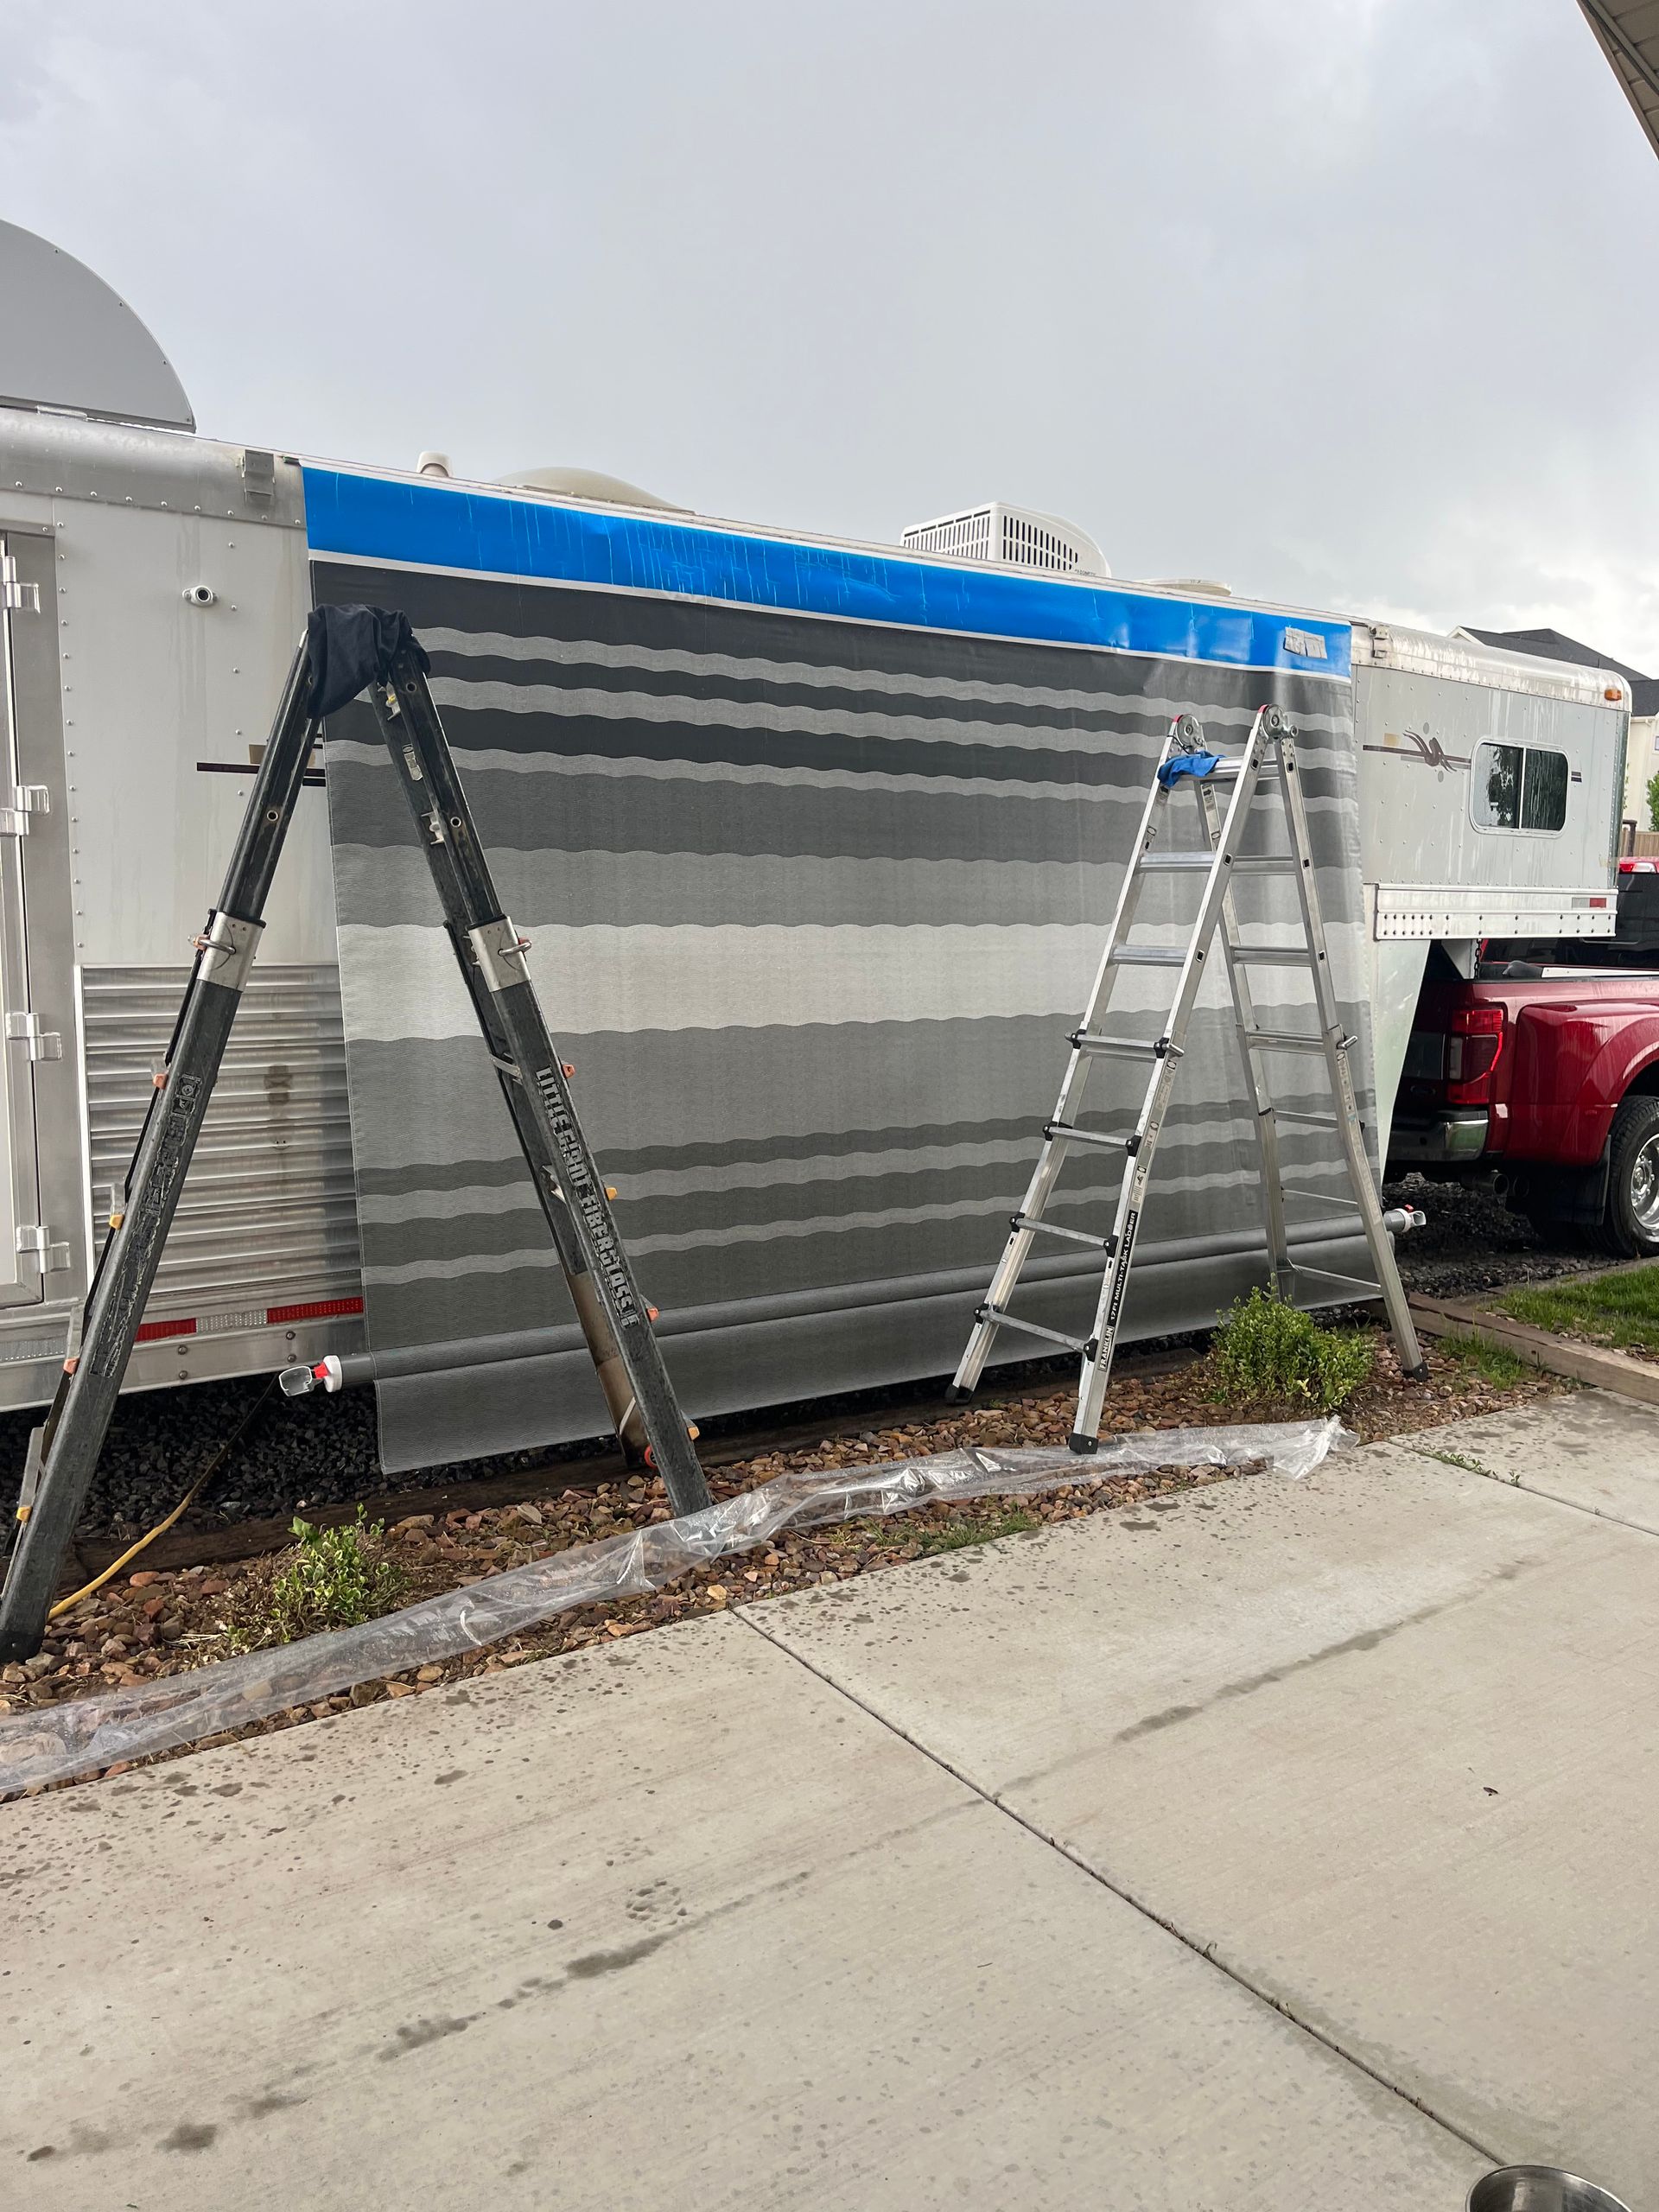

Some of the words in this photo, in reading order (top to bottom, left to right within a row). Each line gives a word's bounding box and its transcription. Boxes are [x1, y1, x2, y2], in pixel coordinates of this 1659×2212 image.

[536, 1065, 570, 1133] LITTLE
[556, 1128, 591, 1187] GIANT
[582, 1194, 632, 1313] FIBERGLASS
[1099, 1325, 1115, 1370] FRANKLIN
